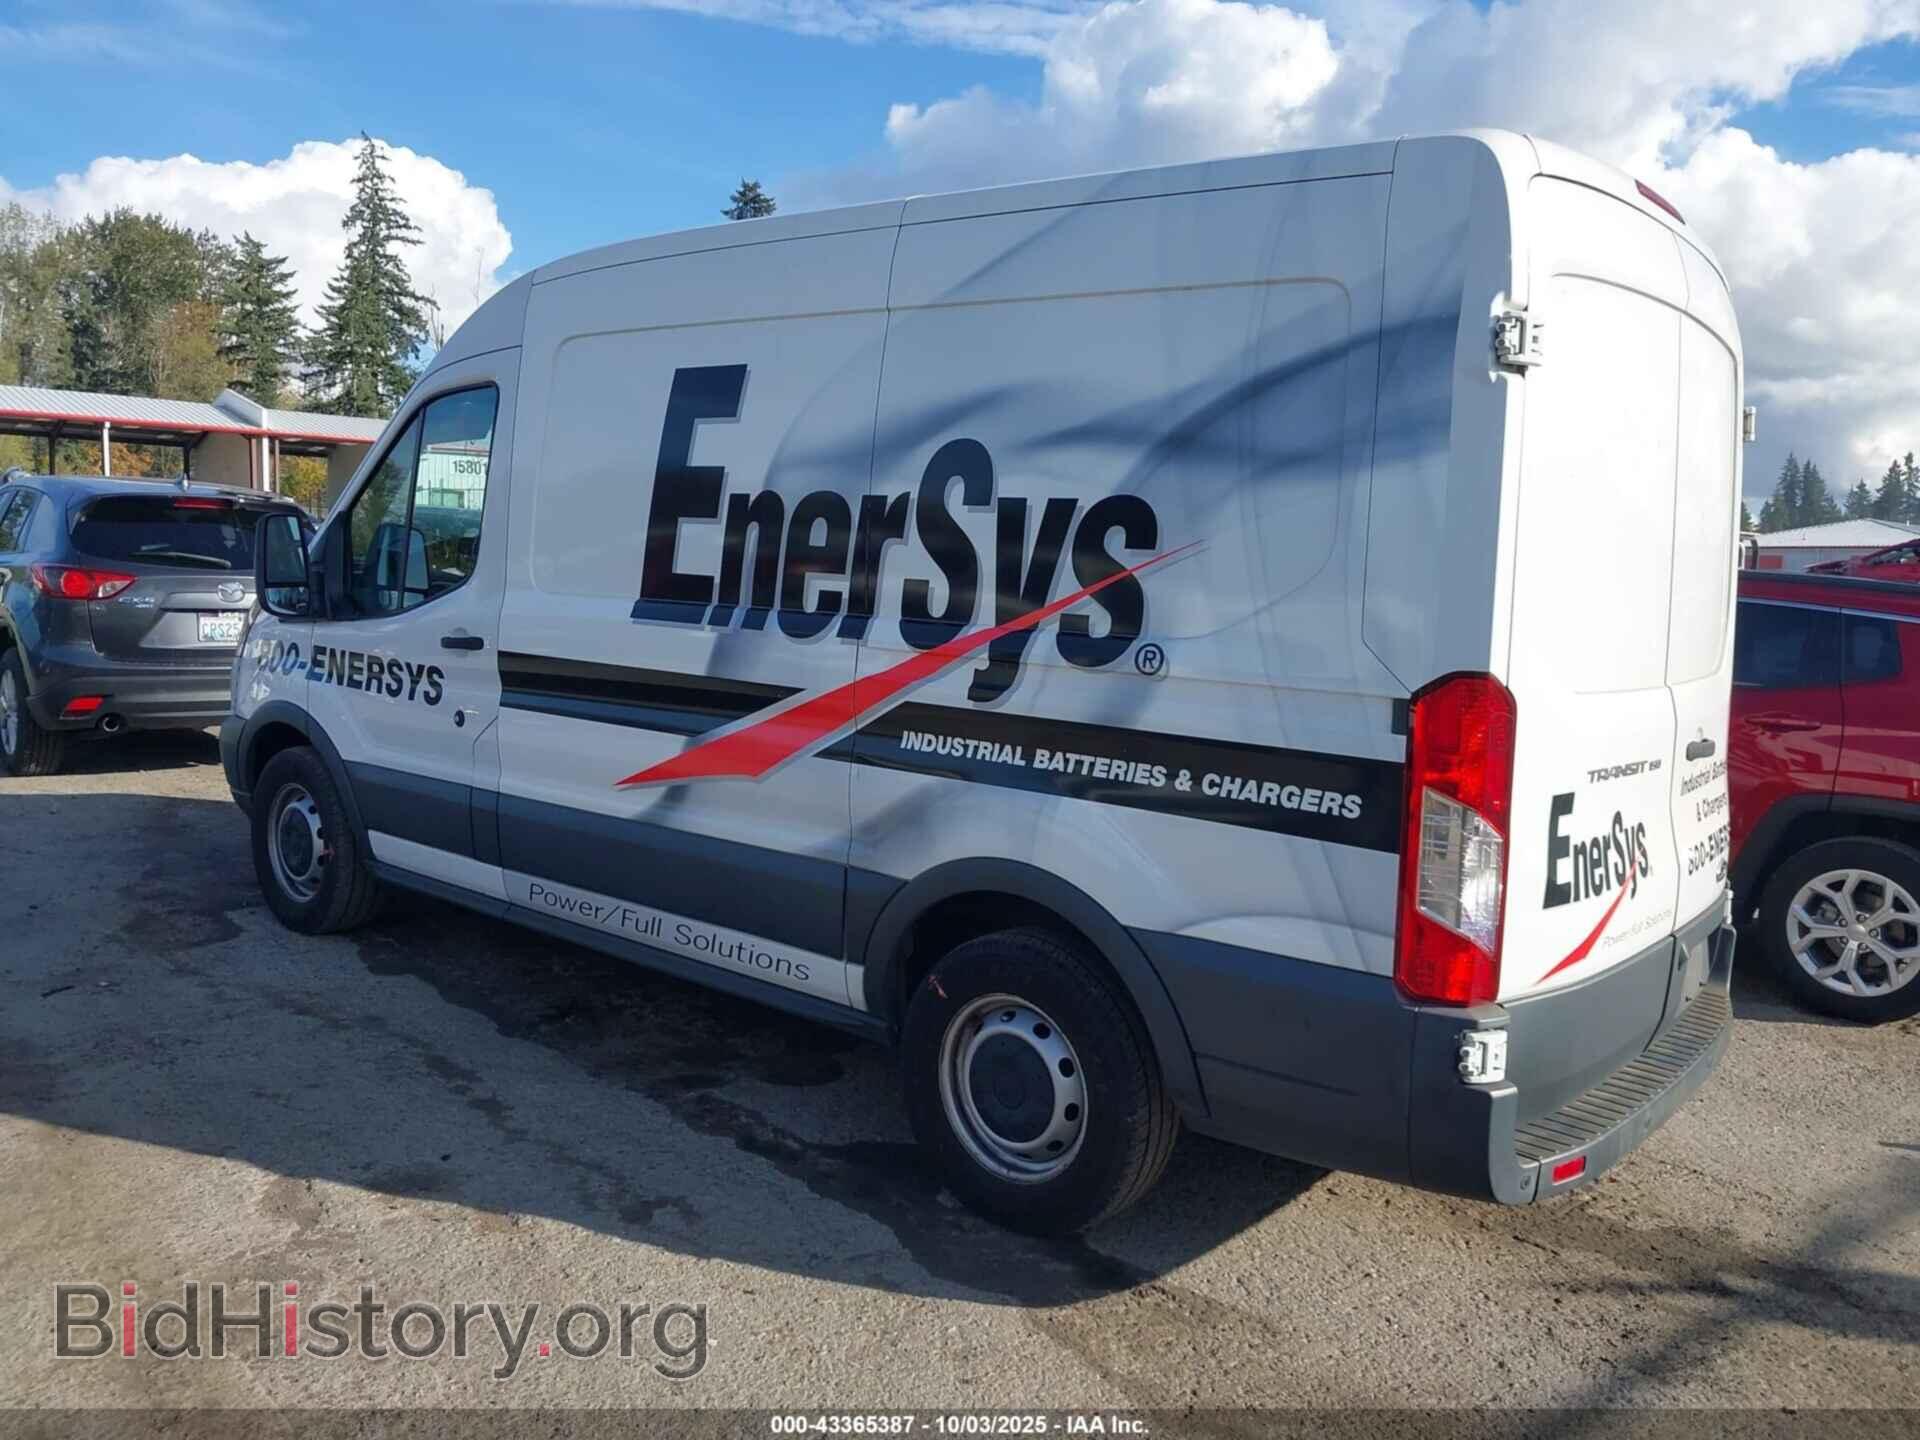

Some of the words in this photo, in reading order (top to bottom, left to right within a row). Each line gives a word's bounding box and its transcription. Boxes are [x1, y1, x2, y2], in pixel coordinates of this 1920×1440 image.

[900, 730, 1026, 767] INDUSTRIAL
[1033, 748, 1167, 788] BATTERIES
[1174, 769, 1193, 792] &
[1201, 772, 1363, 820] CHARGERS
[1587, 760, 1648, 784] TRANSIT
[1542, 792, 1649, 909] EnerSys
[528, 882, 662, 937] Power/Full
[674, 923, 811, 981] Solutions
